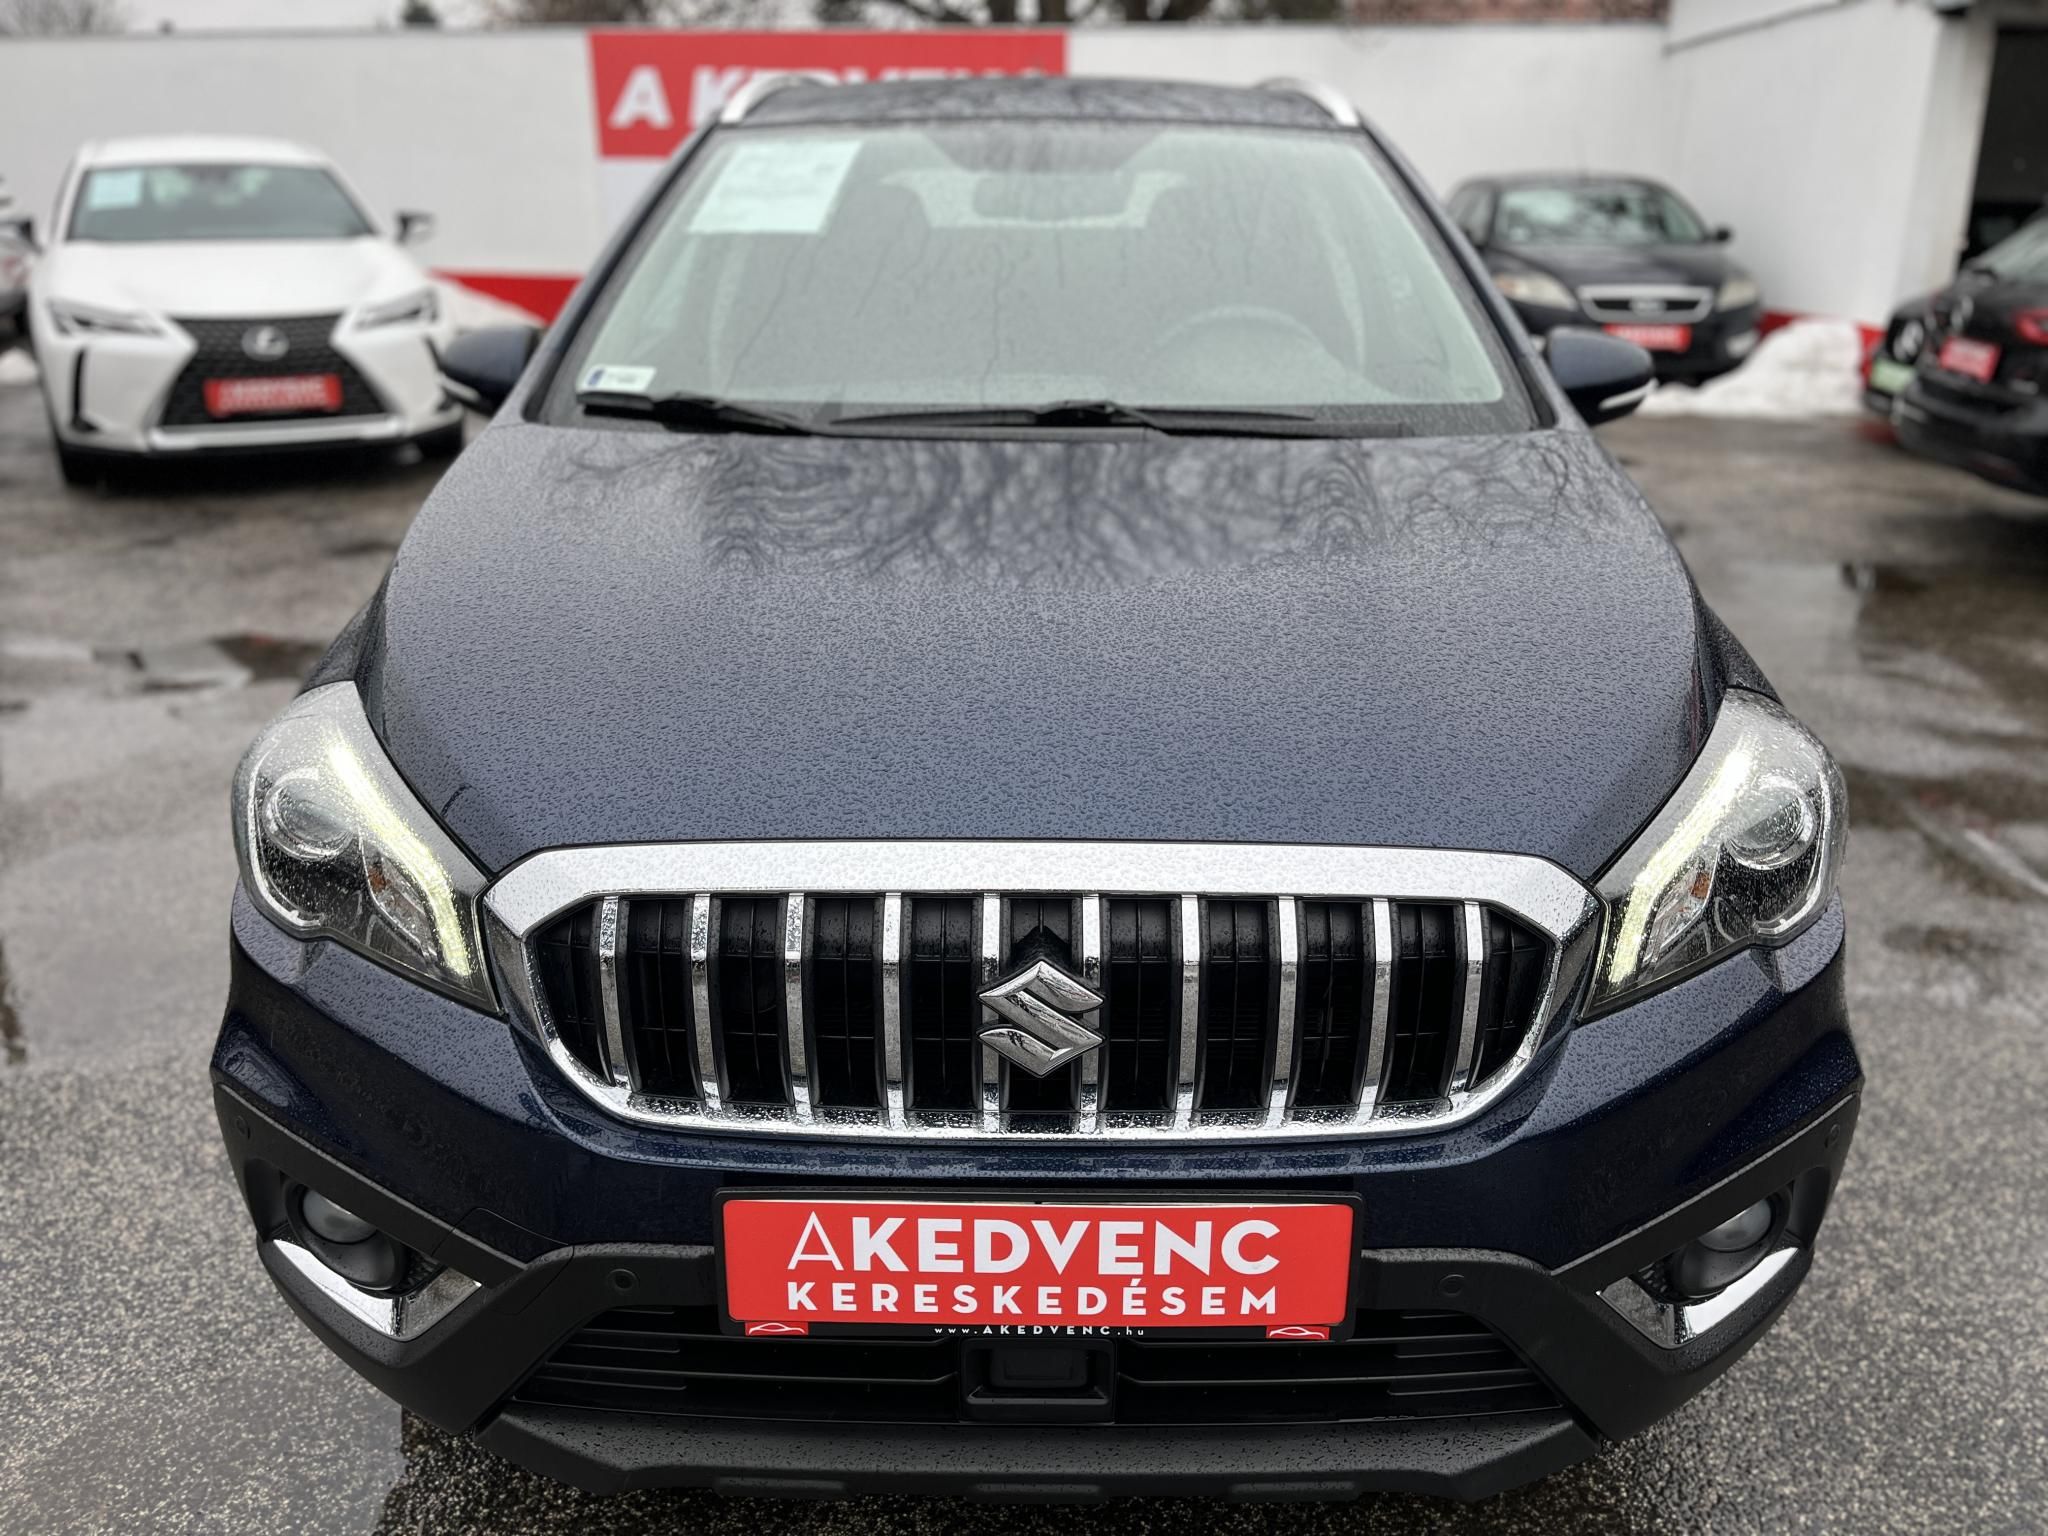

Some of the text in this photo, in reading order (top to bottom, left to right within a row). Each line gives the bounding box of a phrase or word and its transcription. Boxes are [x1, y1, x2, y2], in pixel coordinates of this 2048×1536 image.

[608, 65, 674, 129] A
[787, 1278, 1276, 1316] KERESKEDÉSEM
[934, 1325, 1144, 1336] www.AKEDVENC.hu
